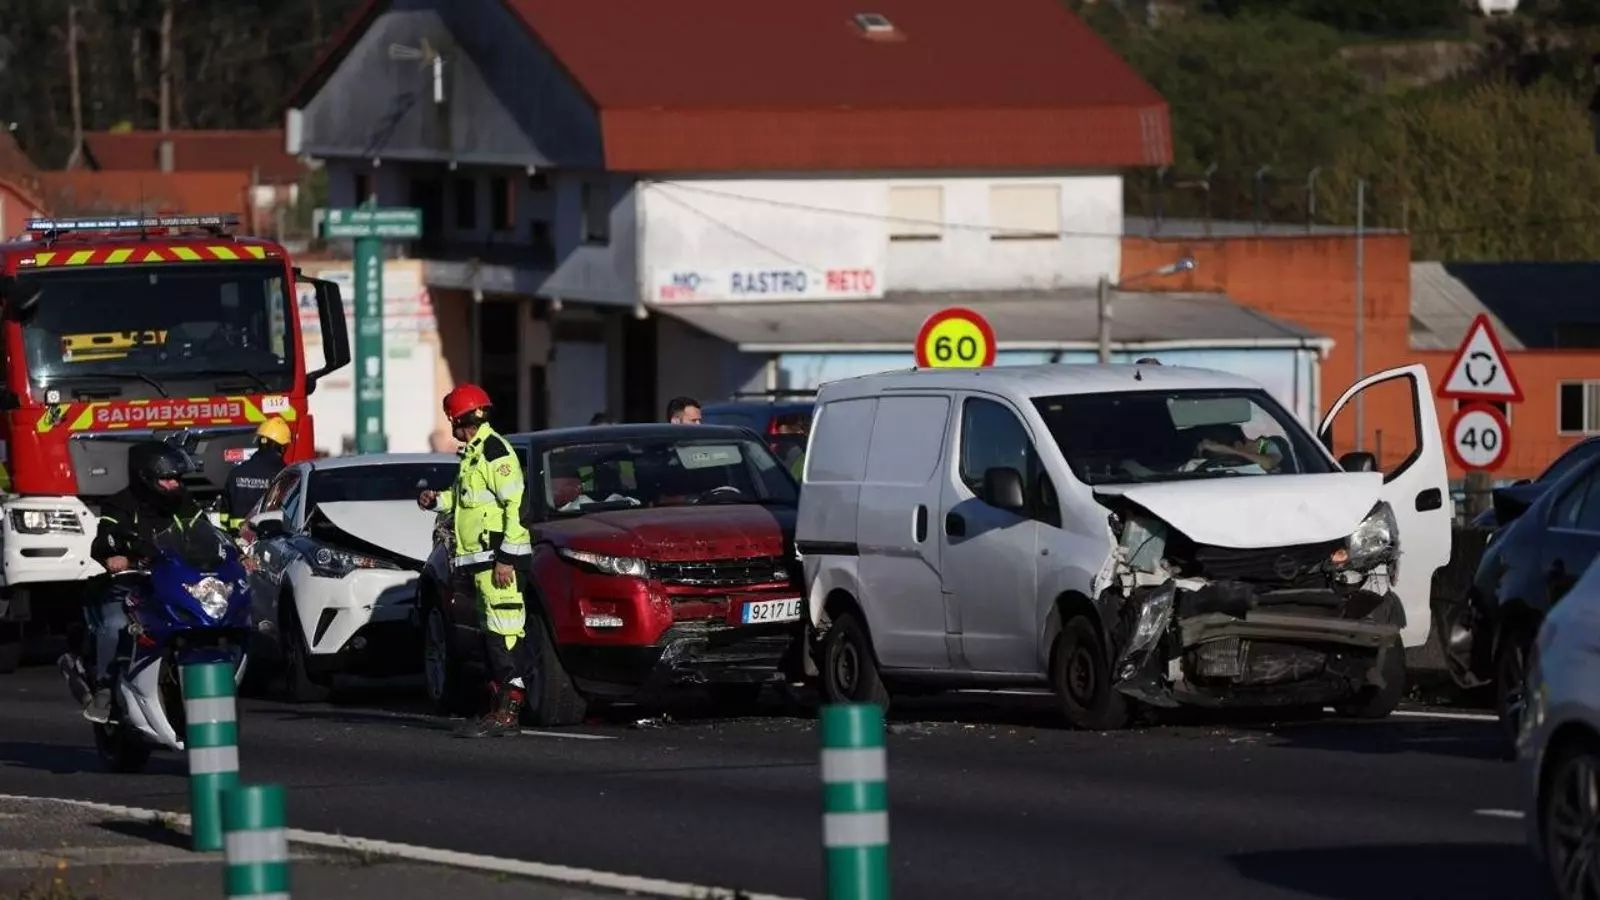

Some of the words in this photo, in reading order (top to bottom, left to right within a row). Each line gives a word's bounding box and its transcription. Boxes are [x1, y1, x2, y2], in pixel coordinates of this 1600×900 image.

[732, 270, 807, 293] RASTRO
[826, 269, 875, 292] RETO
[935, 336, 977, 362] 60
[1461, 427, 1498, 452] 40
[752, 603, 785, 620] 9217
